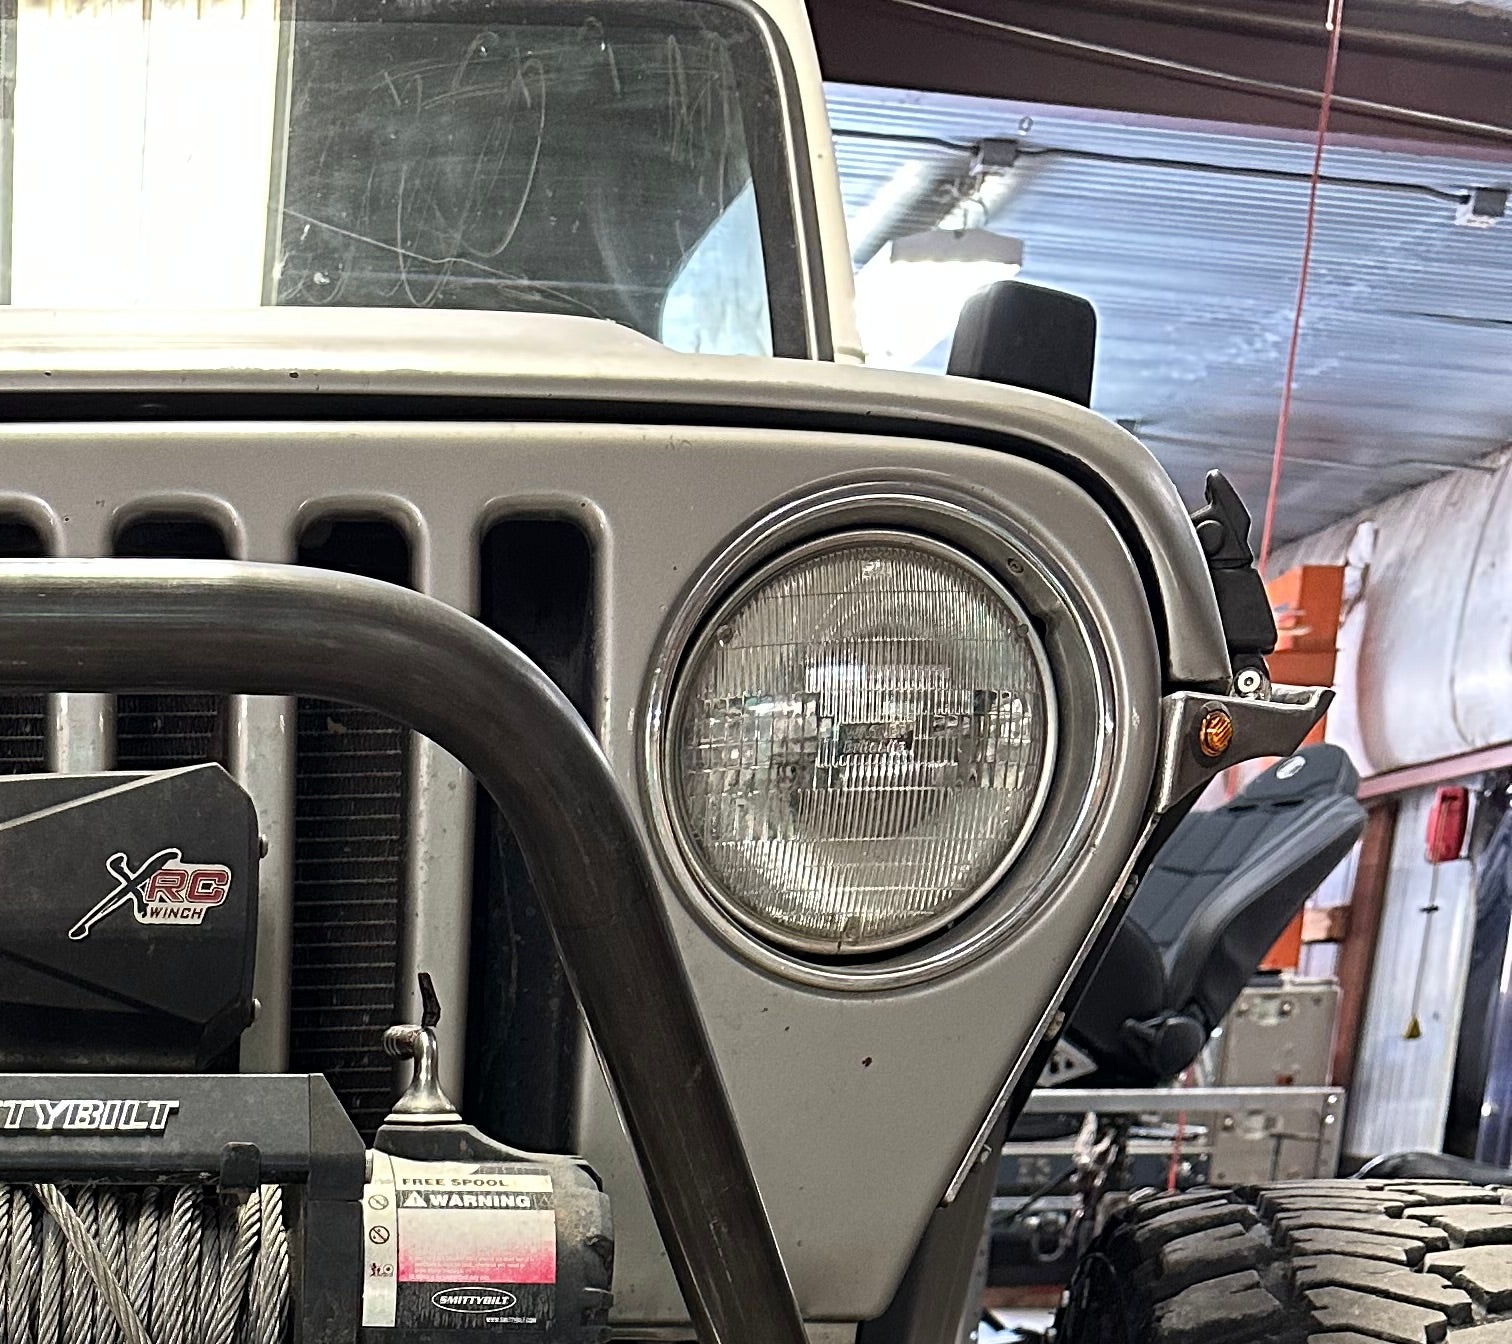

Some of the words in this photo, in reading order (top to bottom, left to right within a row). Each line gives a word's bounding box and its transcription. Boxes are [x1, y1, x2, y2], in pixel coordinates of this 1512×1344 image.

[68, 848, 231, 940] XRC
[149, 906, 204, 920] WINCH
[402, 1177, 445, 1187] FREE
[451, 1177, 509, 1187] SPOOL
[430, 1194, 531, 1208] WARNING
[439, 1295, 510, 1305] SMITTYBILT
